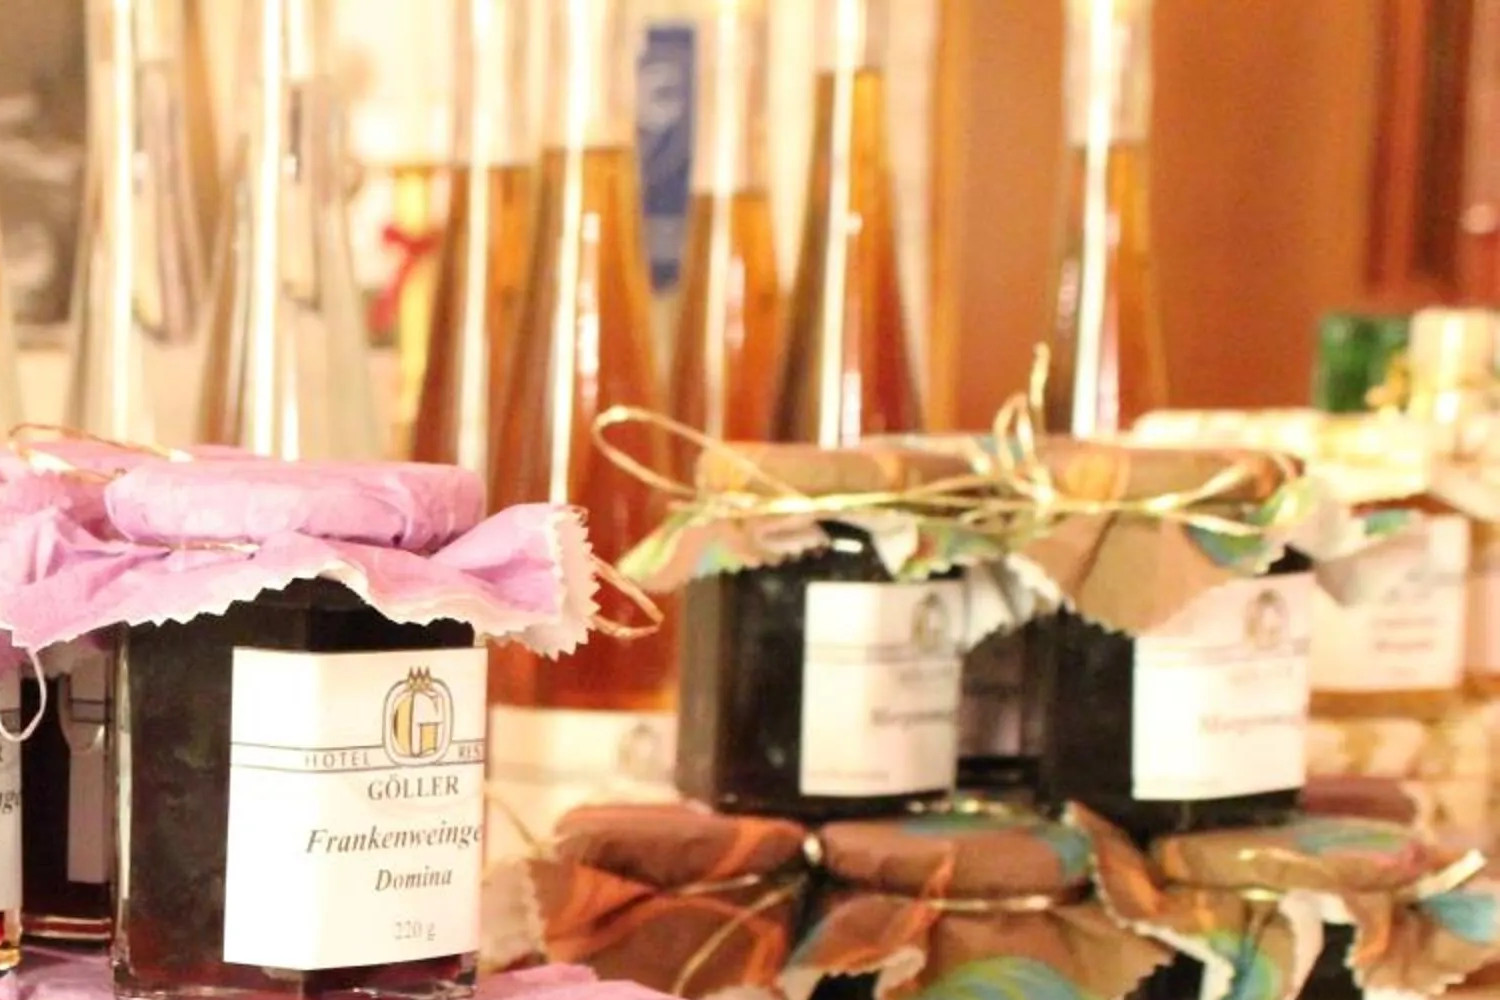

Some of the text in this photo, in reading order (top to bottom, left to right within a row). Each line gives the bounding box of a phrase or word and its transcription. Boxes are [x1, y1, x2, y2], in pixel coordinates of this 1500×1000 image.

[304, 750, 371, 769] HOTEL
[367, 772, 459, 802] GÖLLER
[375, 864, 452, 892] Domina
[395, 920, 422, 941] 220
